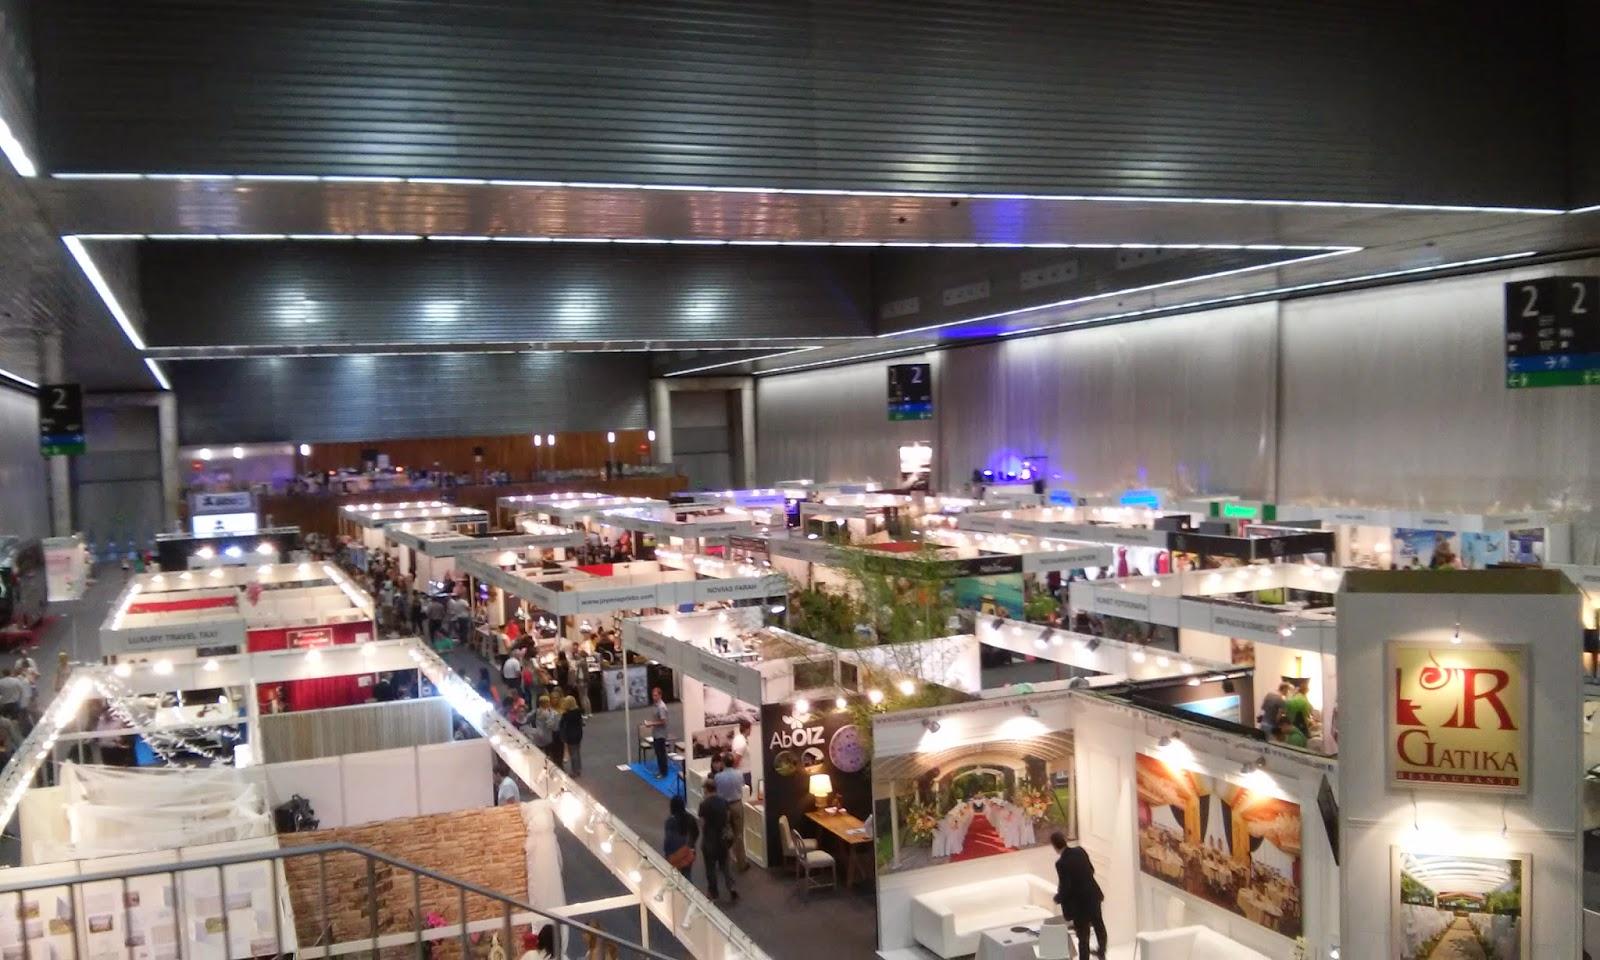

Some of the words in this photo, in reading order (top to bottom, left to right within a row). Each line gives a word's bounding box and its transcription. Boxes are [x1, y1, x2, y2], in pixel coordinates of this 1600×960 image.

[1521, 285, 1540, 317] 2
[1571, 282, 1588, 314] 2
[911, 366, 922, 384] 2
[52, 388, 67, 409] 2
[127, 635, 162, 645] LUXURY
[165, 632, 197, 641] TRAVEL
